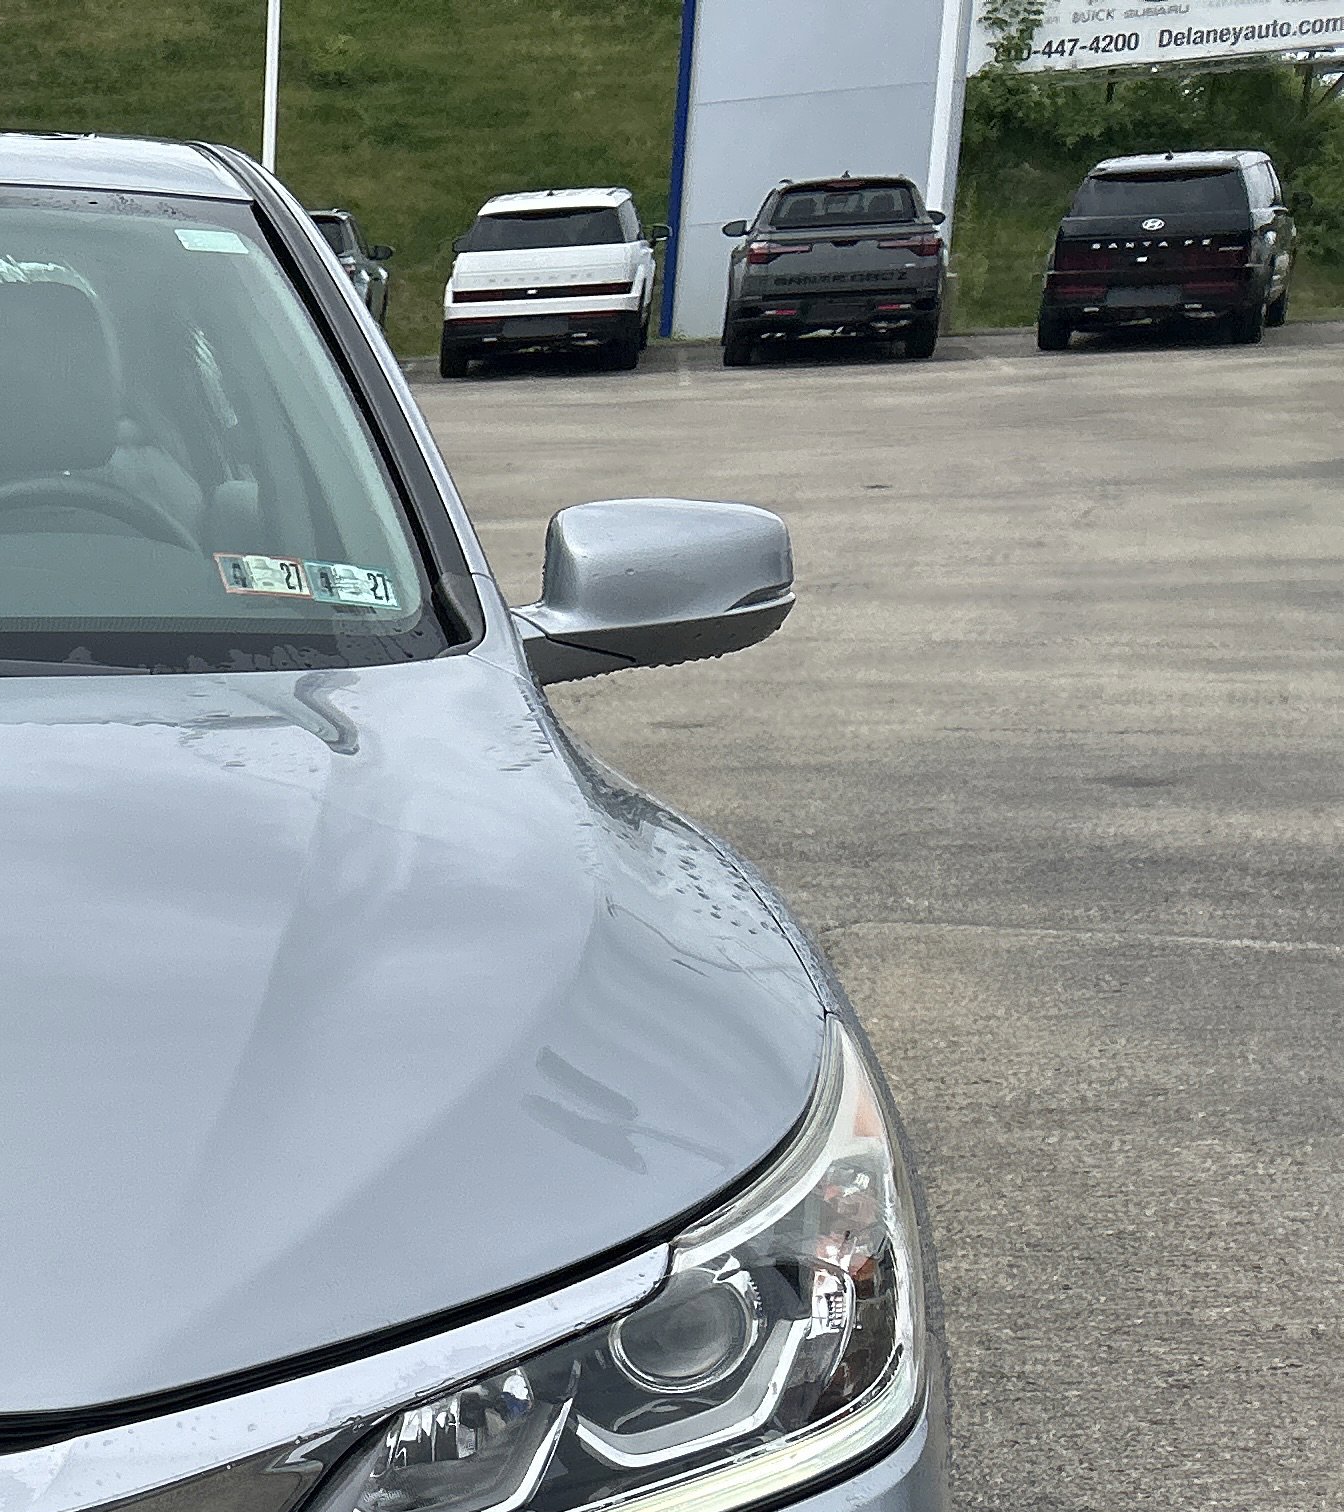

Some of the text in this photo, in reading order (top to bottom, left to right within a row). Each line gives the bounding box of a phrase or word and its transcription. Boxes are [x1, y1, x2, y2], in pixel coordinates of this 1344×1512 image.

[1158, 16, 1344, 47] Delaneyauto.com
[279, 562, 303, 593] 27
[367, 572, 392, 603] 27
